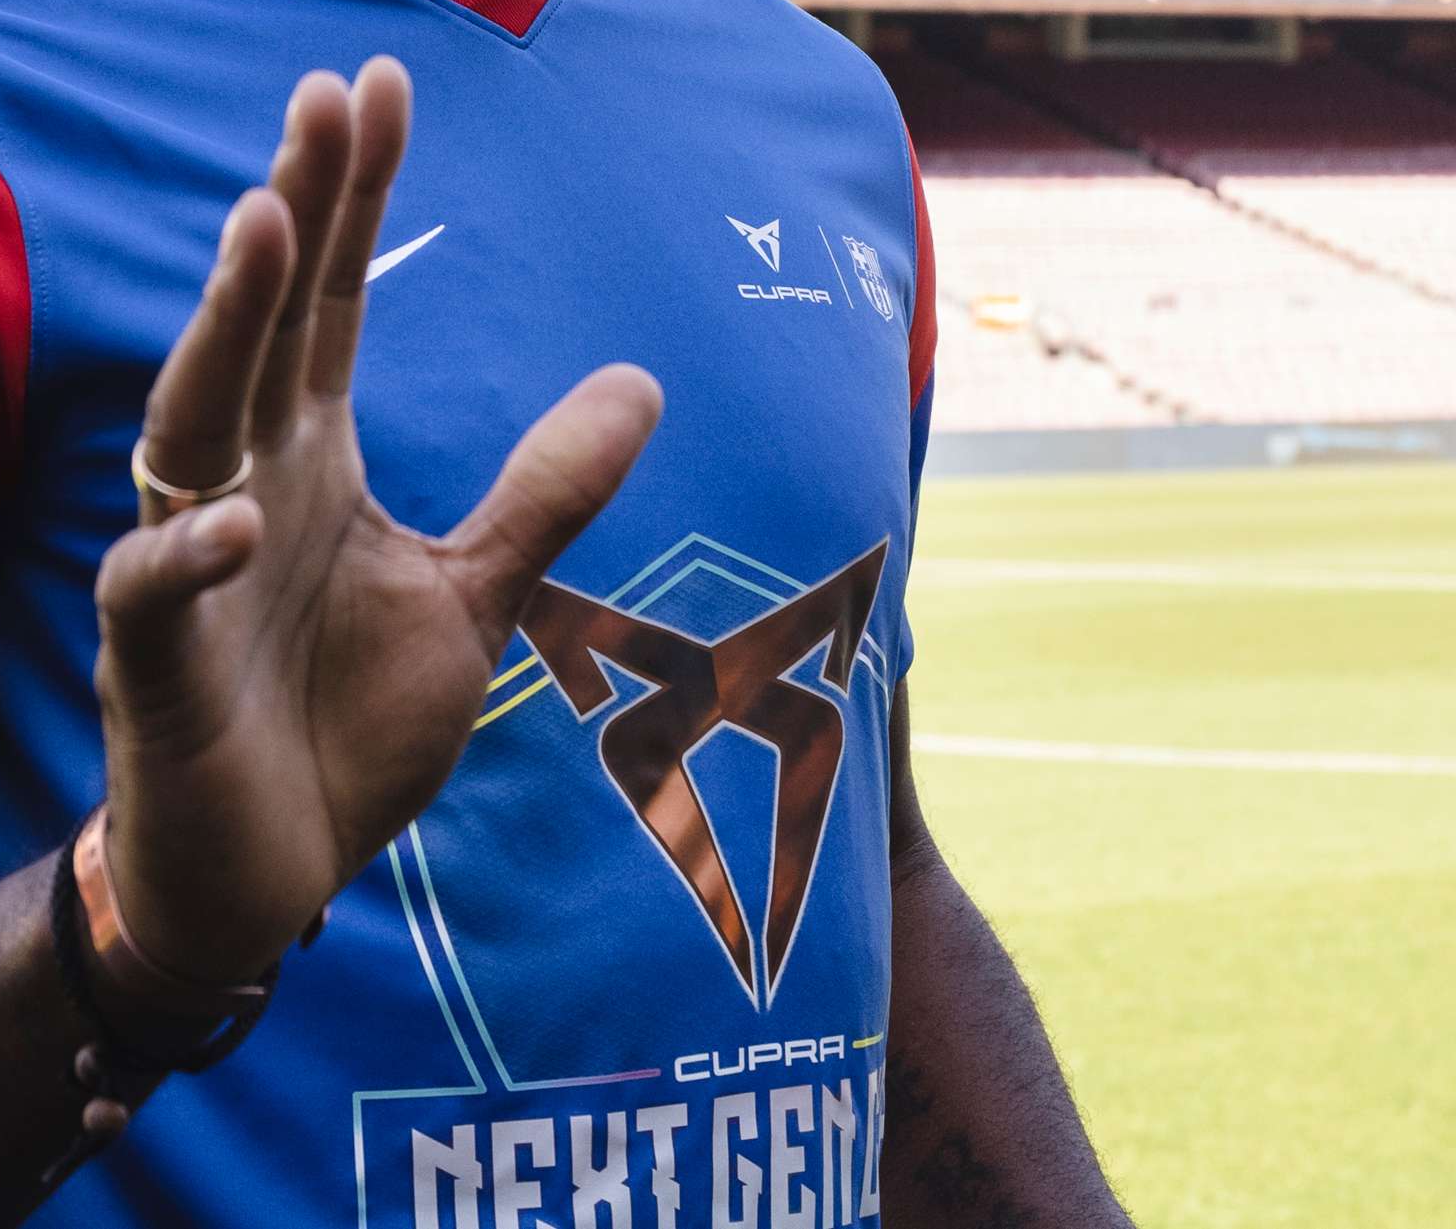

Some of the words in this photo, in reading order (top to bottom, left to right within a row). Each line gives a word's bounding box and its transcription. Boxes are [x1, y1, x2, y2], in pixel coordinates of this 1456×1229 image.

[737, 283, 833, 305] CUPRA
[674, 1034, 845, 1083] CUPRA
[411, 1102, 689, 1229] NEXT
